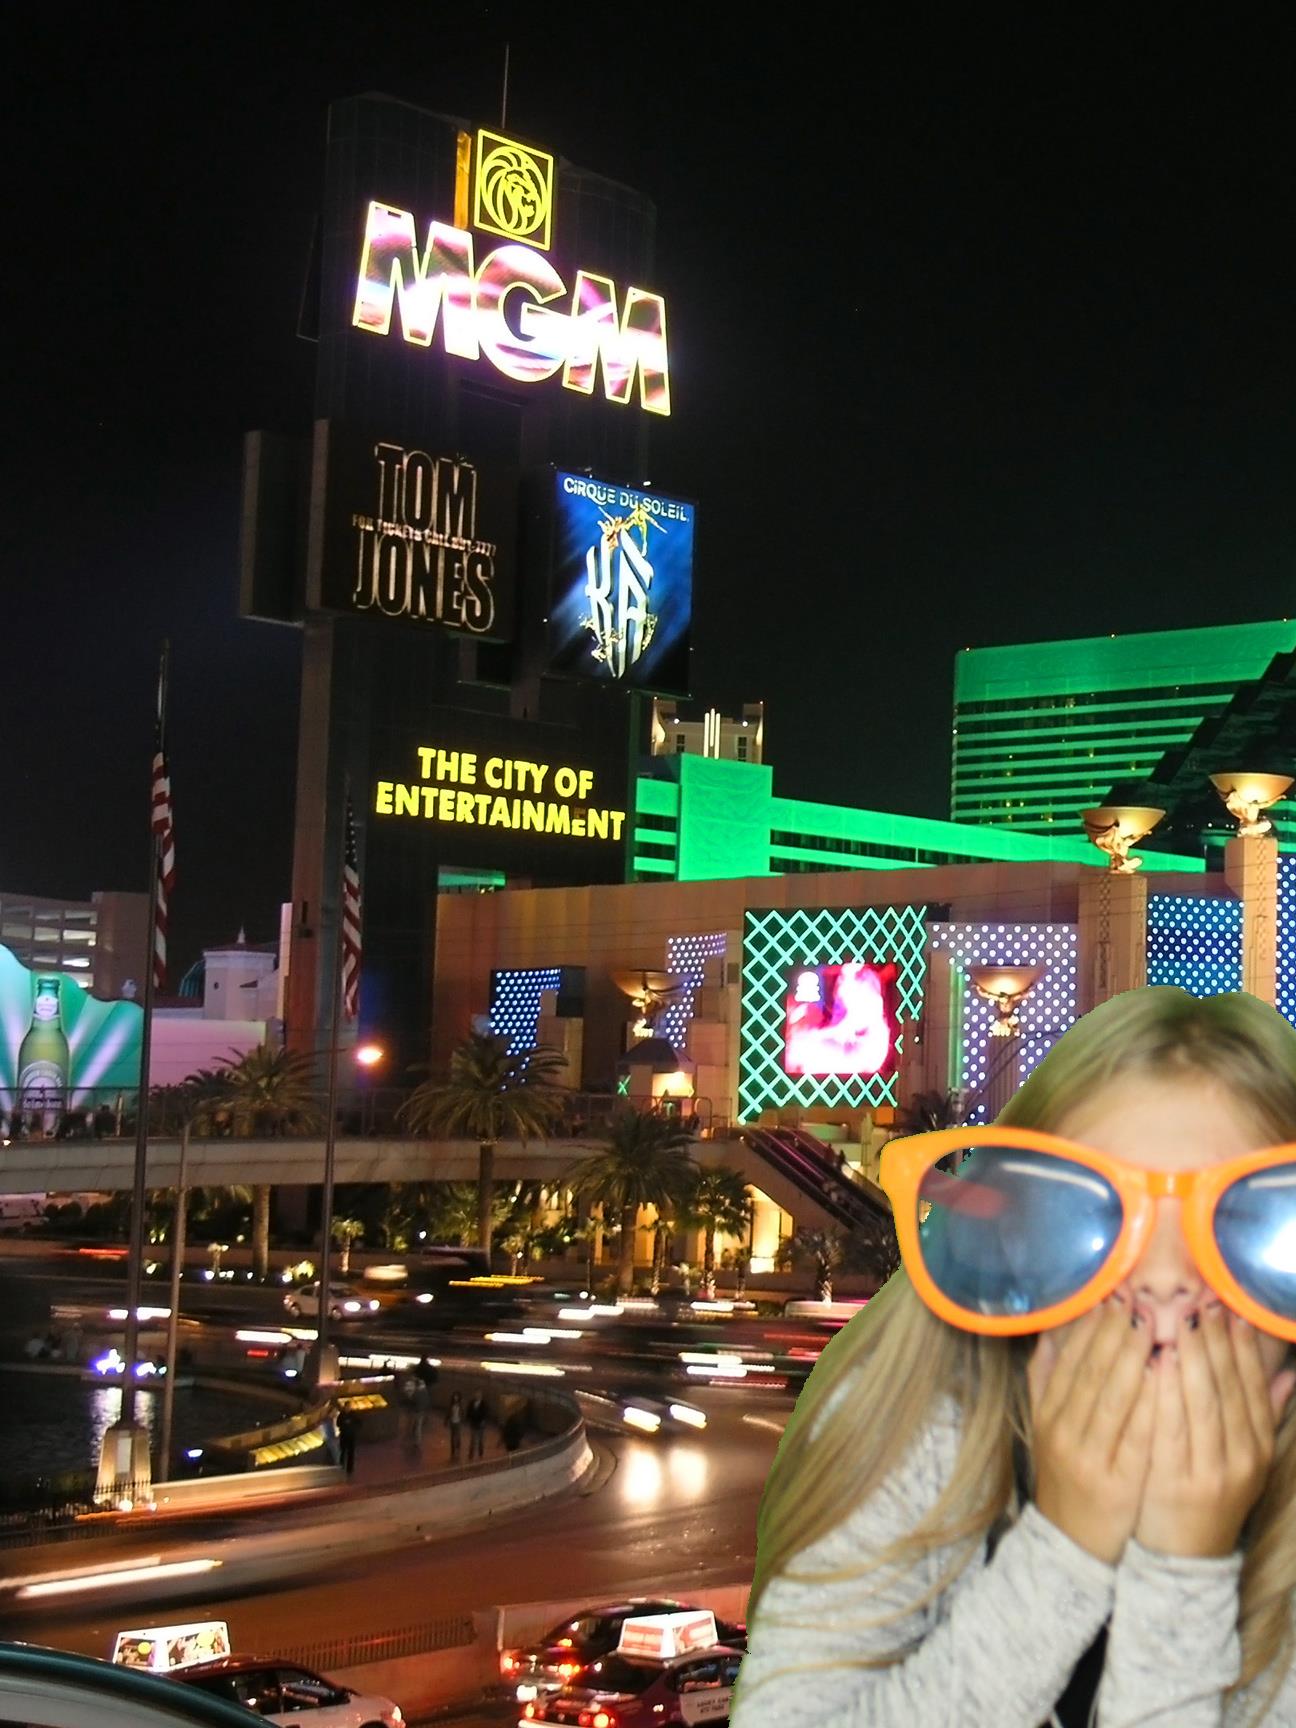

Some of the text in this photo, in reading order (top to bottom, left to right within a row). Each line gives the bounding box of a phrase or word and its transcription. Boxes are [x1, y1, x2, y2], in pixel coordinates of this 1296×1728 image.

[352, 200, 670, 416] MGM
[374, 442, 477, 540] TOM
[563, 477, 690, 522] CIRQUE DU SOLEIL
[352, 524, 496, 633] JONES
[375, 781, 626, 840] ENTERTAINMENT
[417, 746, 594, 800] THE CITY OF
